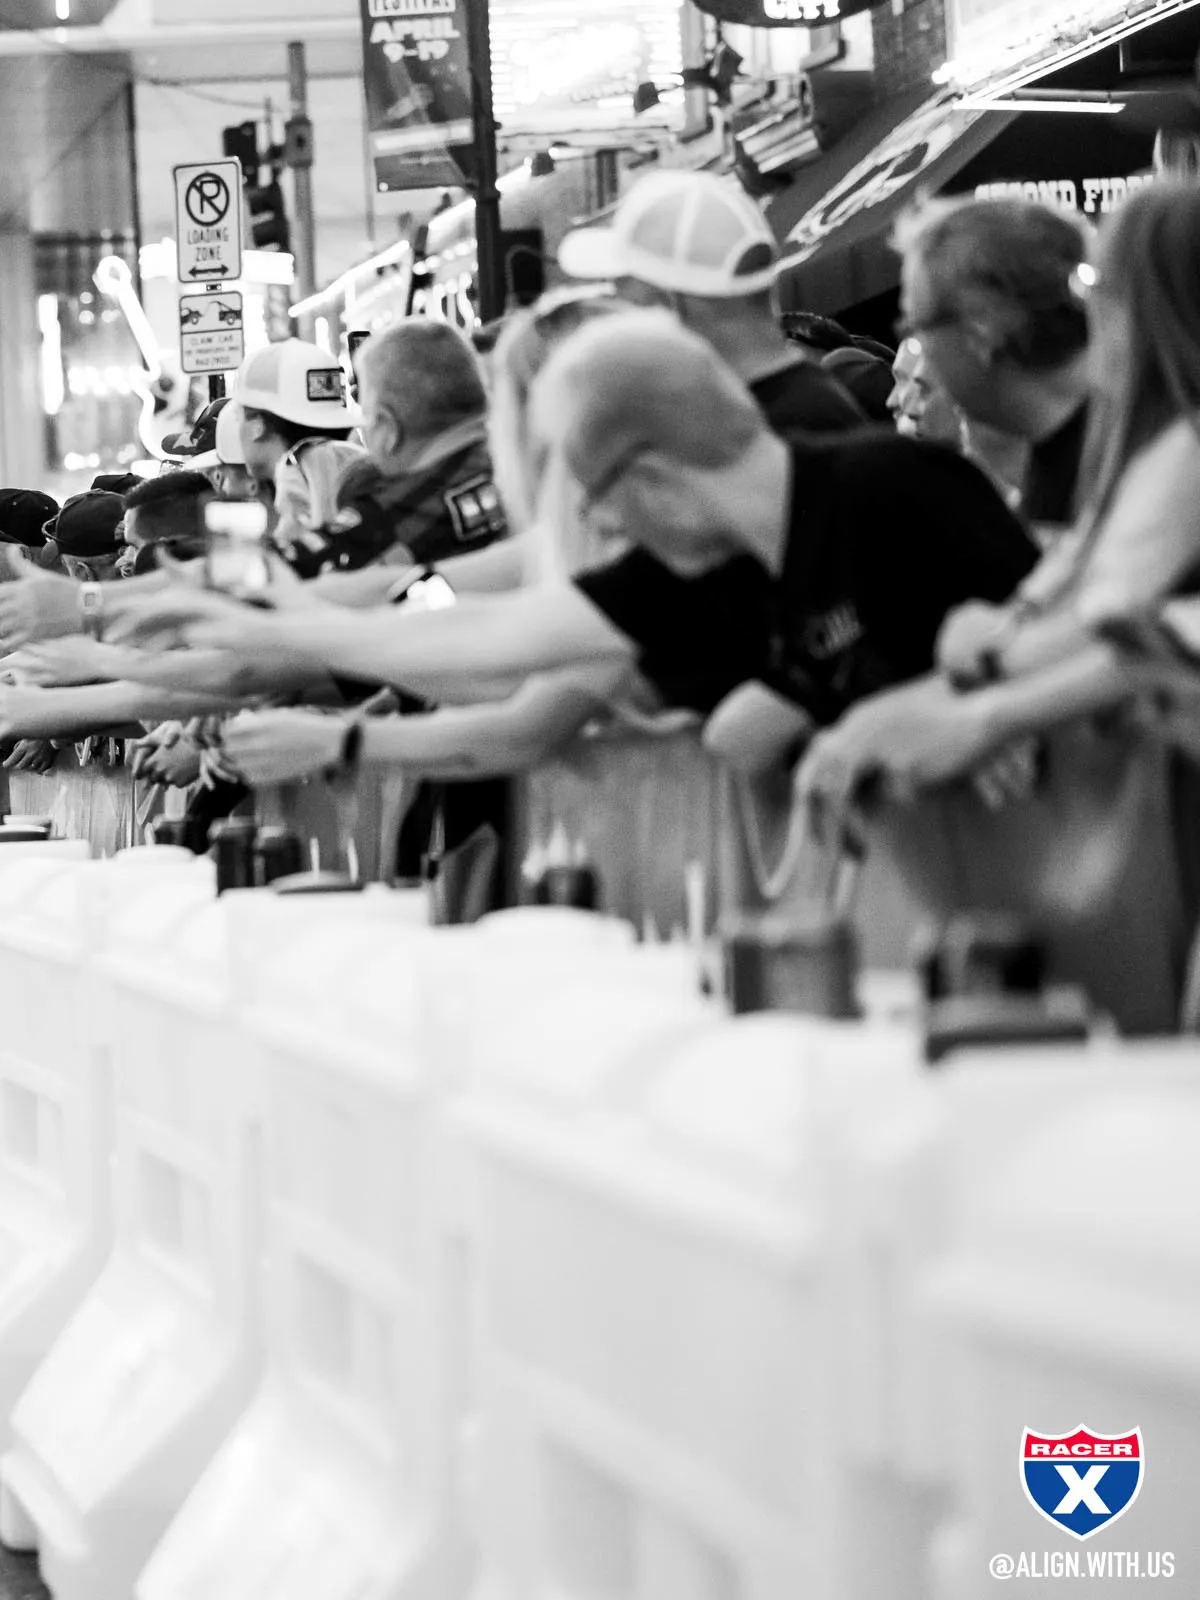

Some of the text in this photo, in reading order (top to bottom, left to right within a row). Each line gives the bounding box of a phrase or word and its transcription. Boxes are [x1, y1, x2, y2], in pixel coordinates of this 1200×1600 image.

[370, 17, 460, 43] APRIL
[187, 229, 229, 245] LOADING
[196, 246, 222, 262] ZONE
